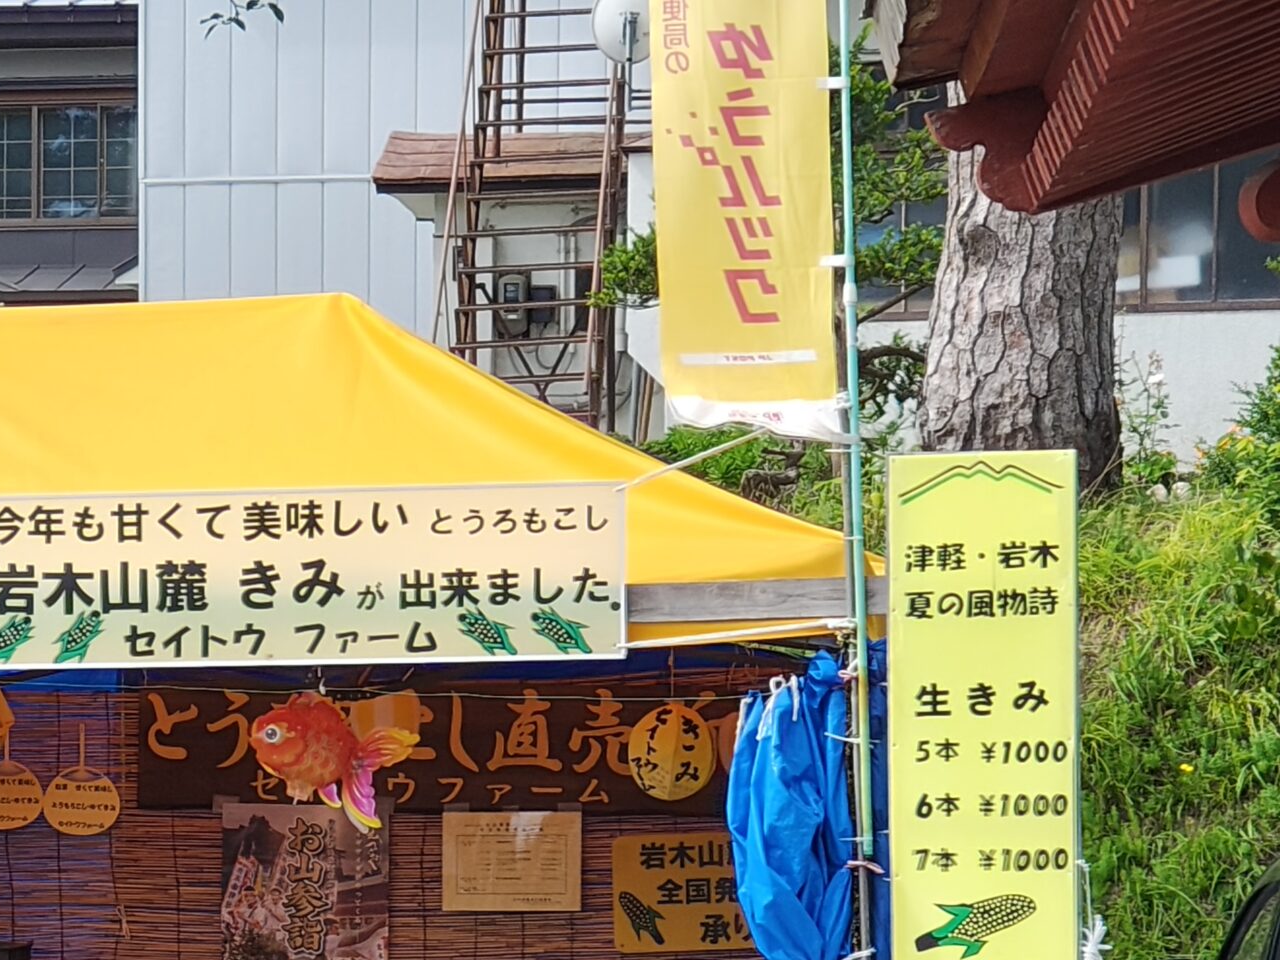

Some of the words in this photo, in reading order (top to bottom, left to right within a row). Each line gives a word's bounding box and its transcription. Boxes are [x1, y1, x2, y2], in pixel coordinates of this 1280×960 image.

[430, 504, 609, 535] とうろもこし
[904, 540, 1060, 572] 津軽・岩木
[904, 587, 1059, 619] 夏の風物詩
[915, 738, 960, 763] 5本
[980, 739, 1068, 764] ¥1000
[915, 792, 960, 819] 6本
[979, 793, 1068, 818] ¥1000
[640, 840, 734, 870] 岩木山
[283, 816, 330, 951] お山参詣
